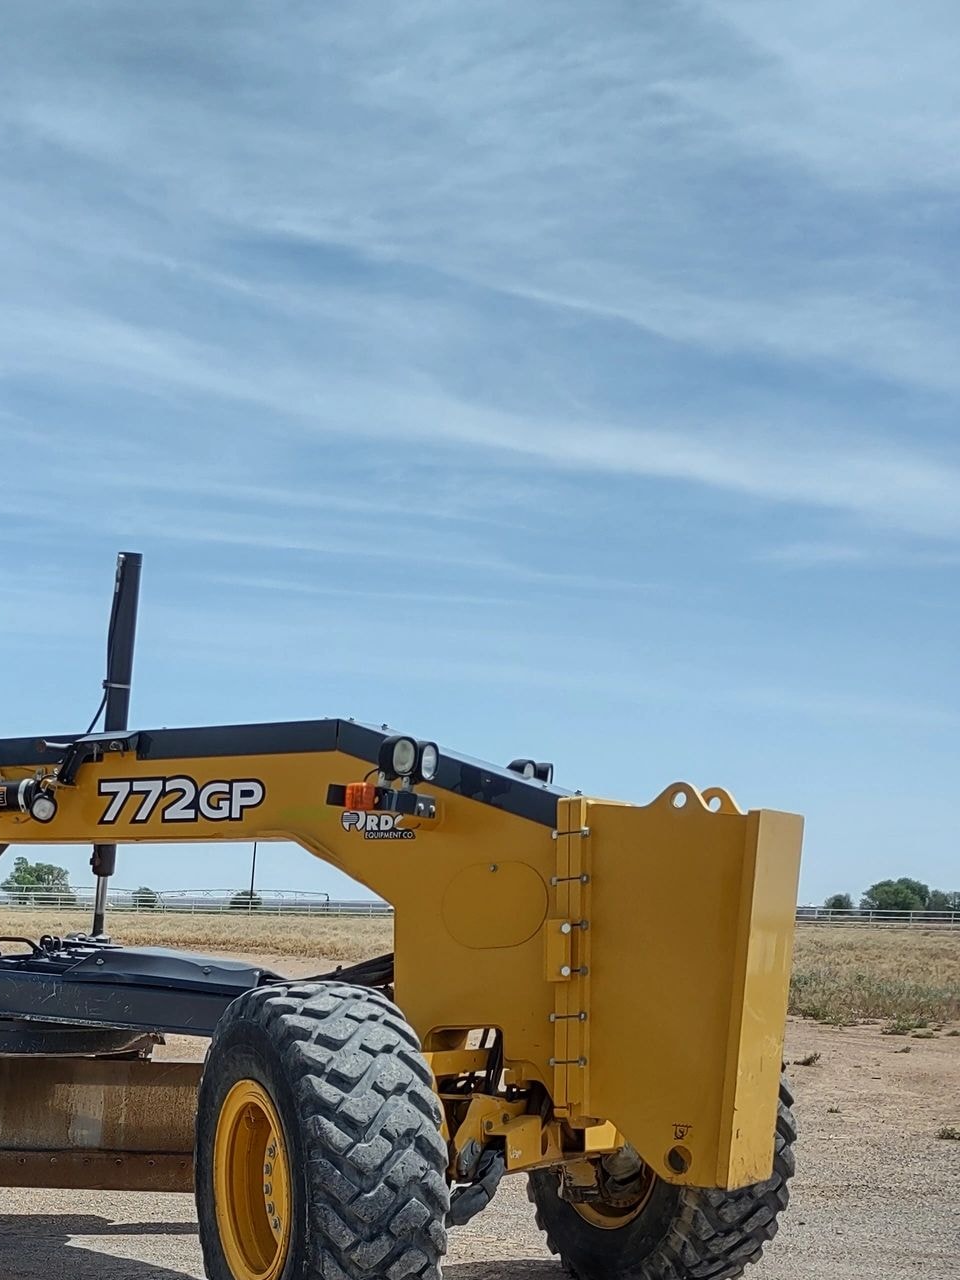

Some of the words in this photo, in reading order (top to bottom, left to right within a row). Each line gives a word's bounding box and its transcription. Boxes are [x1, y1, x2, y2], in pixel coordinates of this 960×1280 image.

[98, 775, 265, 824] 772GP
[365, 831, 402, 839] EQUIPMENT
[402, 831, 415, 839] CO.
